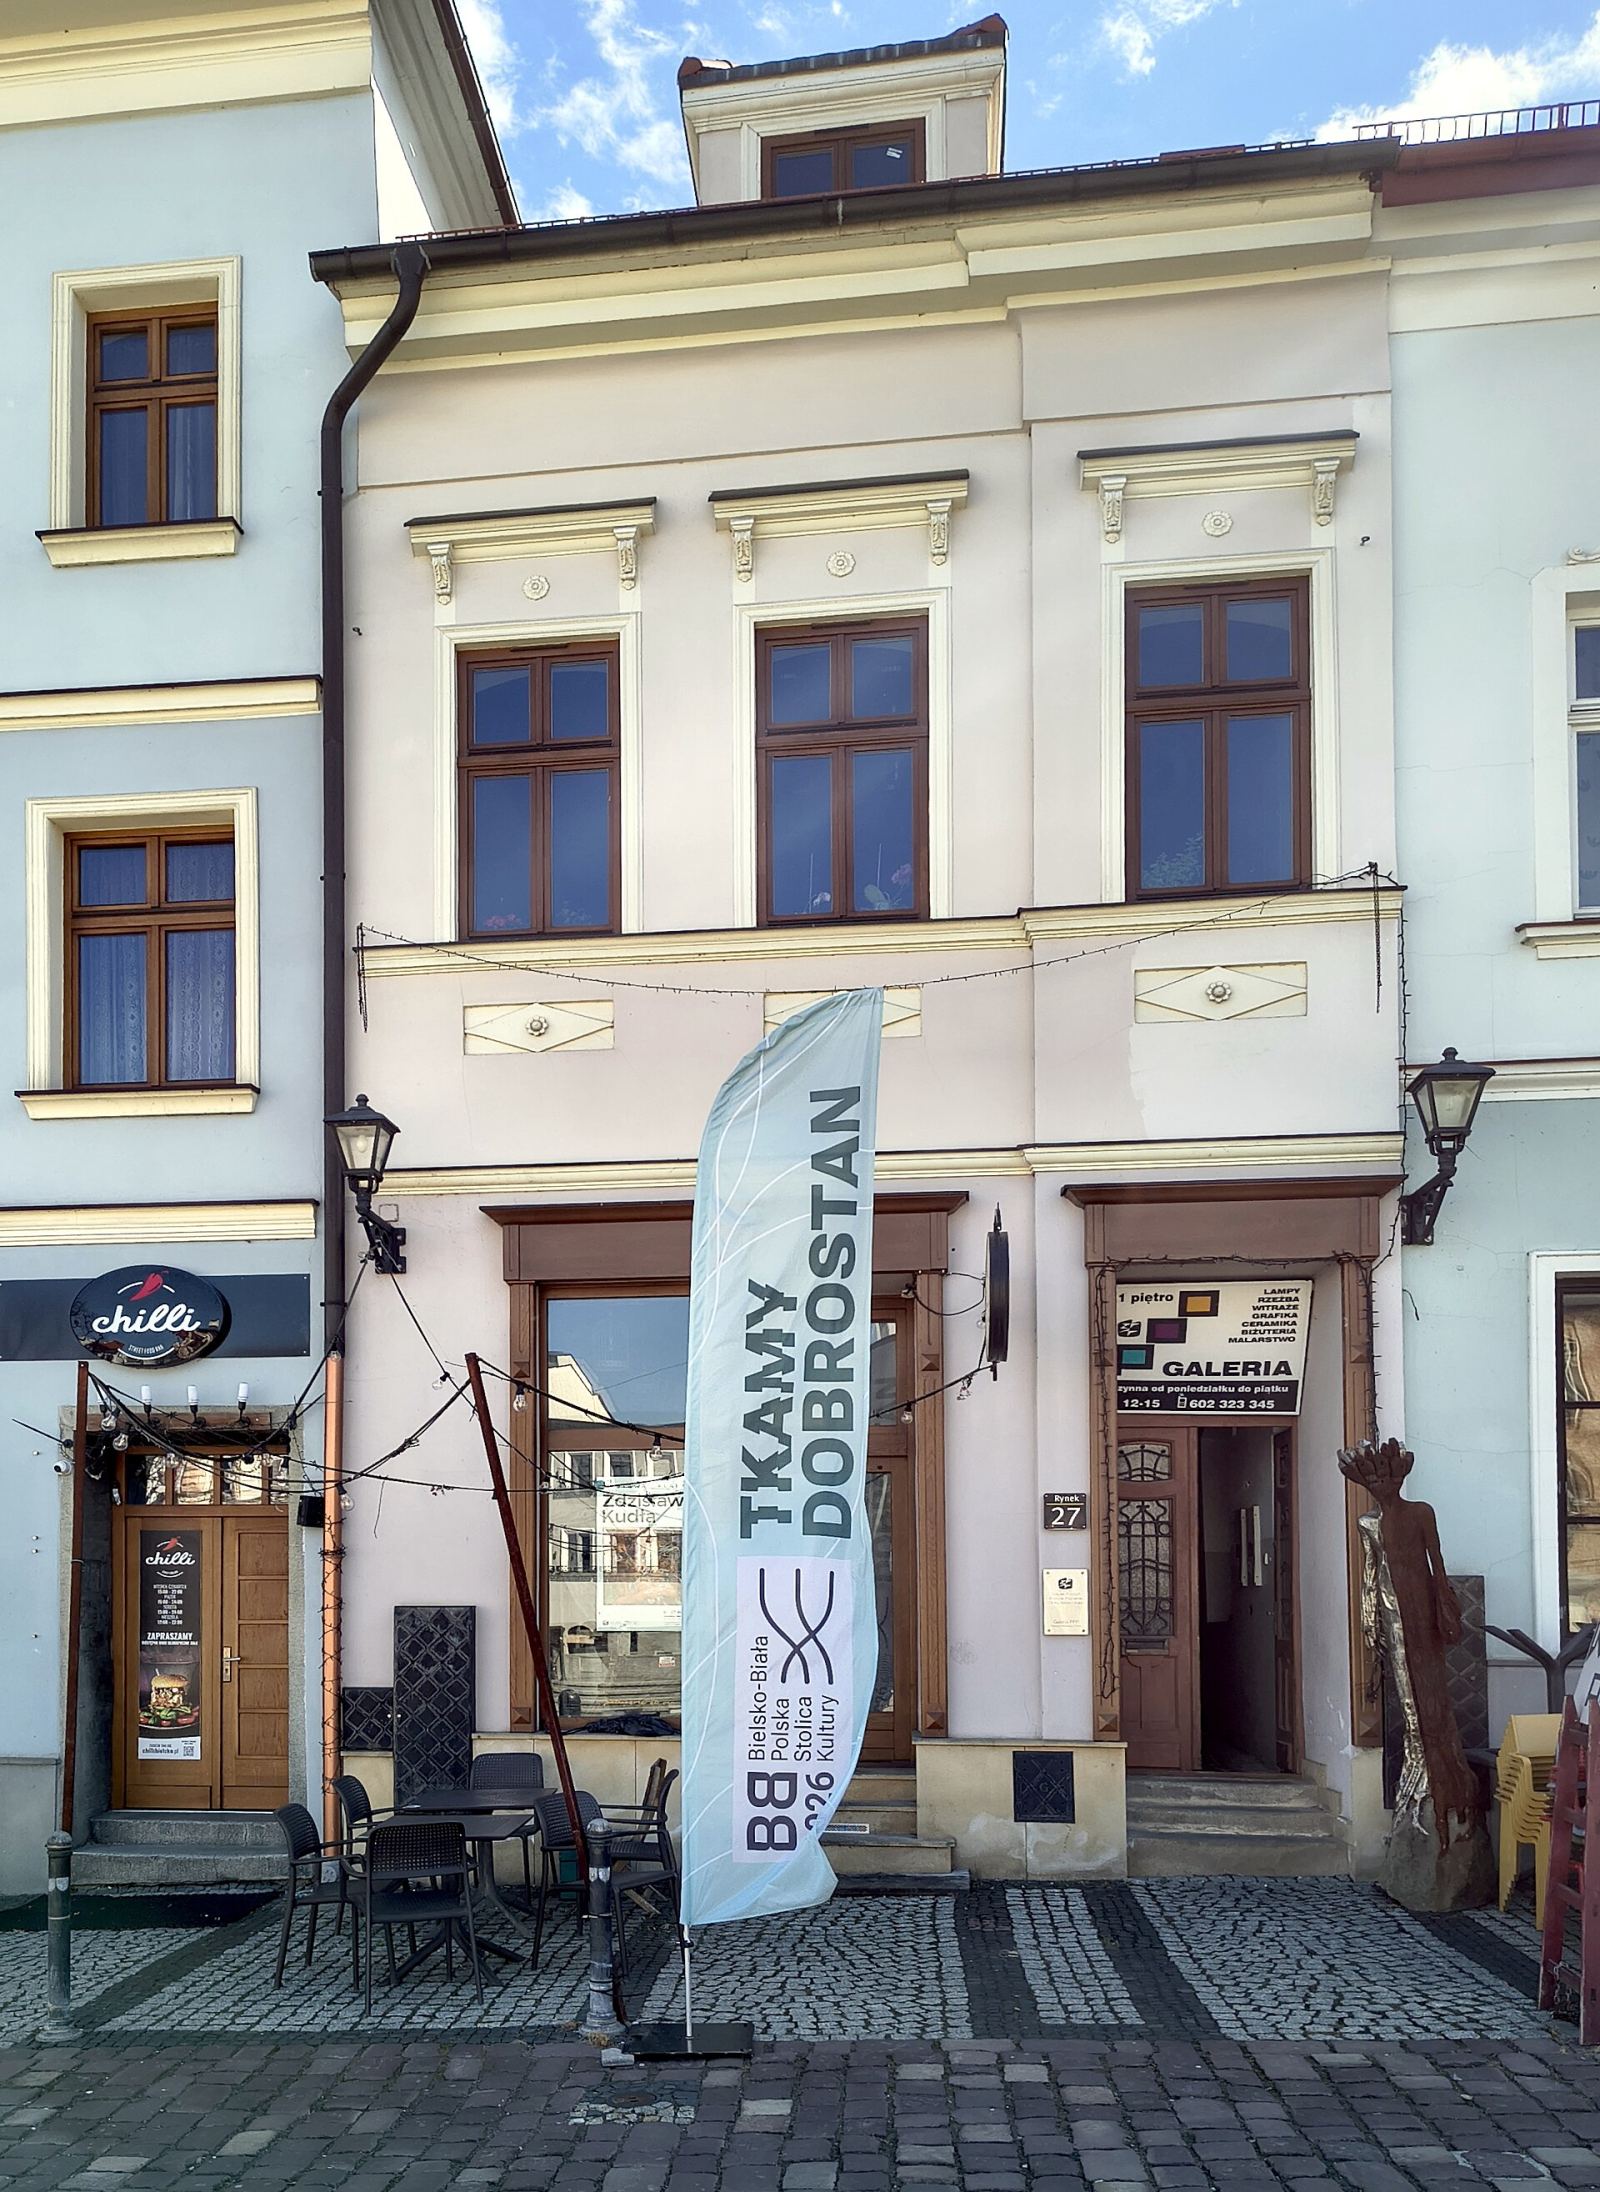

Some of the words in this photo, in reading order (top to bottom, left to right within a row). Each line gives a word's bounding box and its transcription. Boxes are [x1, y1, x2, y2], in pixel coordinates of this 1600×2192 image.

[1118, 1292, 1125, 1303] 1
[1131, 1292, 1174, 1304] piętro
[91, 1303, 201, 1333] chilli
[801, 1085, 861, 1539] DOBROSTAN
[1162, 1360, 1293, 1377] GALERIA
[1117, 1385, 1149, 1393] zynna
[1237, 1385, 1251, 1393] do
[1254, 1385, 1289, 1394] piątku
[739, 1278, 798, 1539] TKAMY
[1122, 1399, 1161, 1408] 12-15
[1189, 1399, 1215, 1409] 602
[1219, 1399, 1245, 1409] 323
[1248, 1399, 1275, 1409] 345
[1054, 1494, 1080, 1503] Rynek
[1051, 1506, 1081, 1526] 27
[145, 1551, 196, 1565] chilli
[147, 1632, 193, 1641] ZAPRASZAMY
[748, 1635, 769, 1761] Bielsko-Biała
[771, 1698, 790, 1761] Polska
[793, 1696, 813, 1762] Stolica
[816, 1694, 840, 1762] Kultury
[746, 1771, 798, 1851] BB
